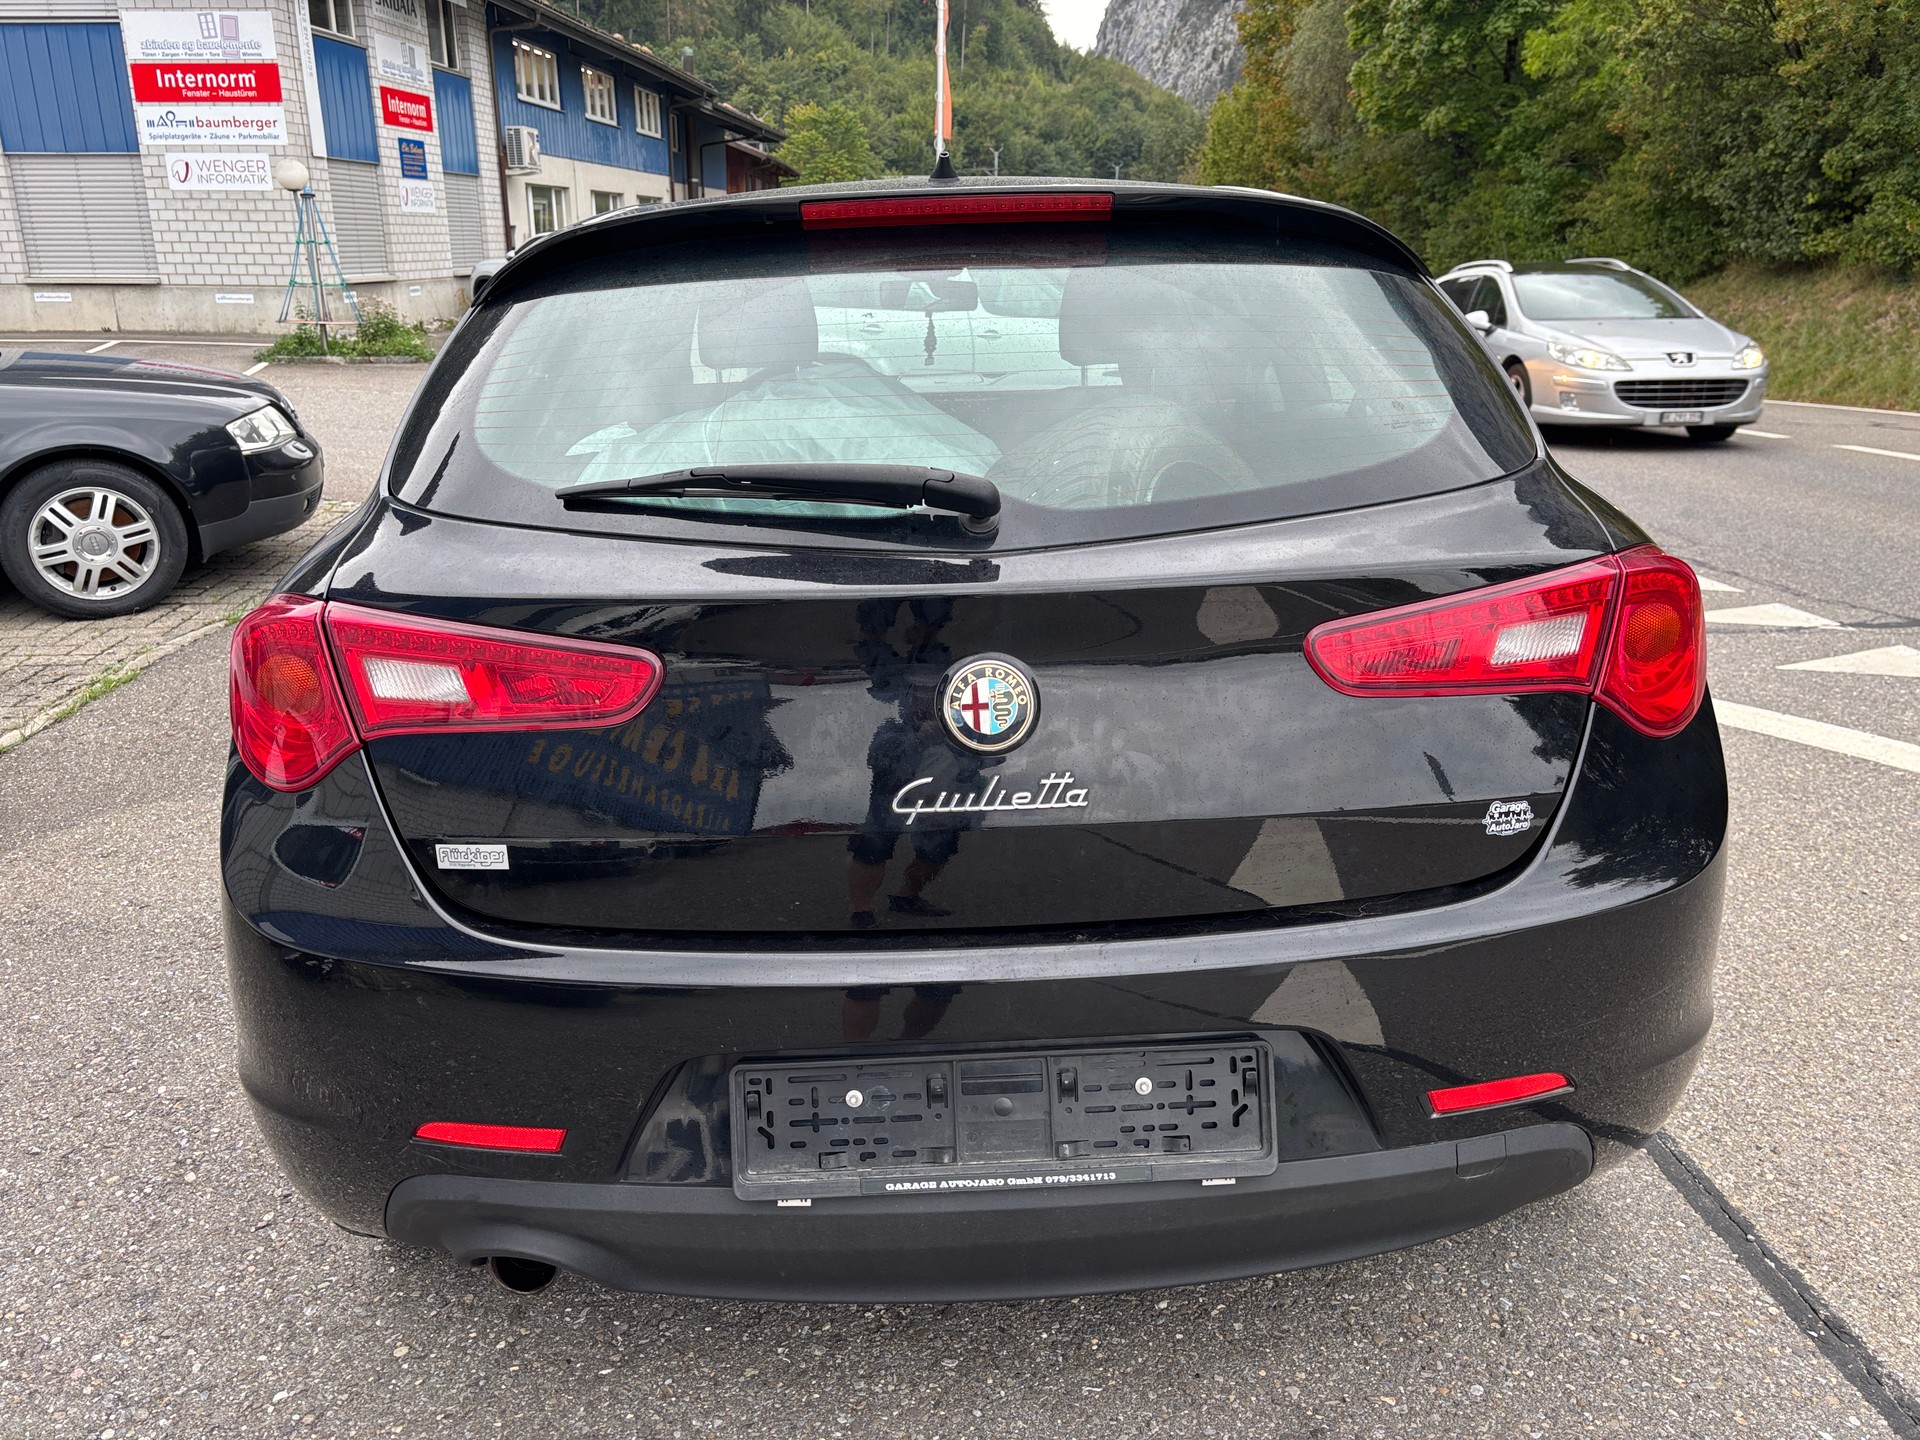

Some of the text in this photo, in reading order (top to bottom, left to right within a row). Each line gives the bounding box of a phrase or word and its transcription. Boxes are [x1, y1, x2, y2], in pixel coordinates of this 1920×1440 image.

[182, 41, 194, 51] ag
[197, 40, 262, 50] bauelemente
[156, 69, 257, 88] Internorm
[182, 89, 258, 97] Fenster Haustüren
[387, 94, 427, 118] Internorm
[195, 115, 278, 131] baumberger
[209, 132, 230, 140] Zäune
[196, 160, 267, 173] WENGER
[197, 174, 268, 184] INFORMATIK
[951, 667, 1028, 710] ALFA ROMEO
[892, 771, 1089, 826] Giulietta
[1492, 802, 1527, 813] Garage
[885, 1172, 1116, 1191] GARAGE AUTOJARO GmbH 079/3341713
